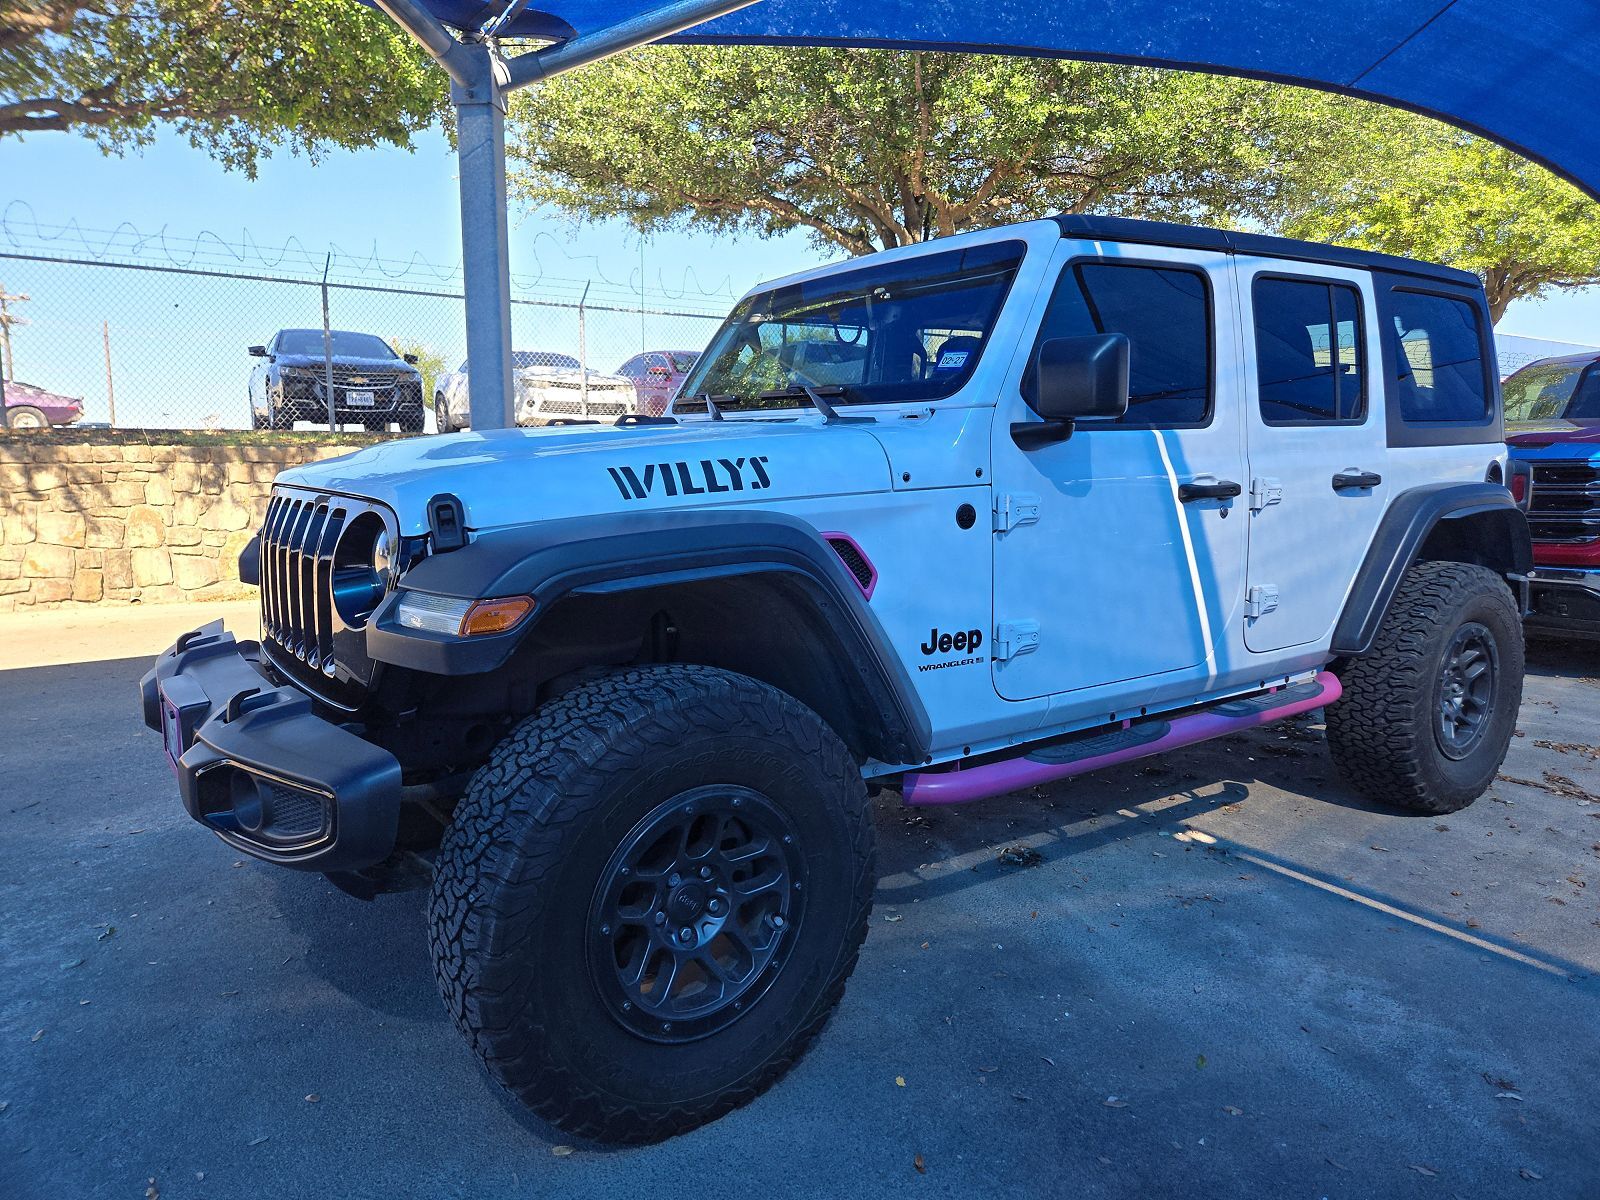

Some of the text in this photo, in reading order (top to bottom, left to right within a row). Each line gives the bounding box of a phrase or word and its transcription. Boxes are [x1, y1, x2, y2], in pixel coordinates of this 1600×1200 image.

[607, 456, 771, 500] WILLYS
[921, 628, 982, 655] Jeep
[918, 658, 974, 672] WRANGLER
